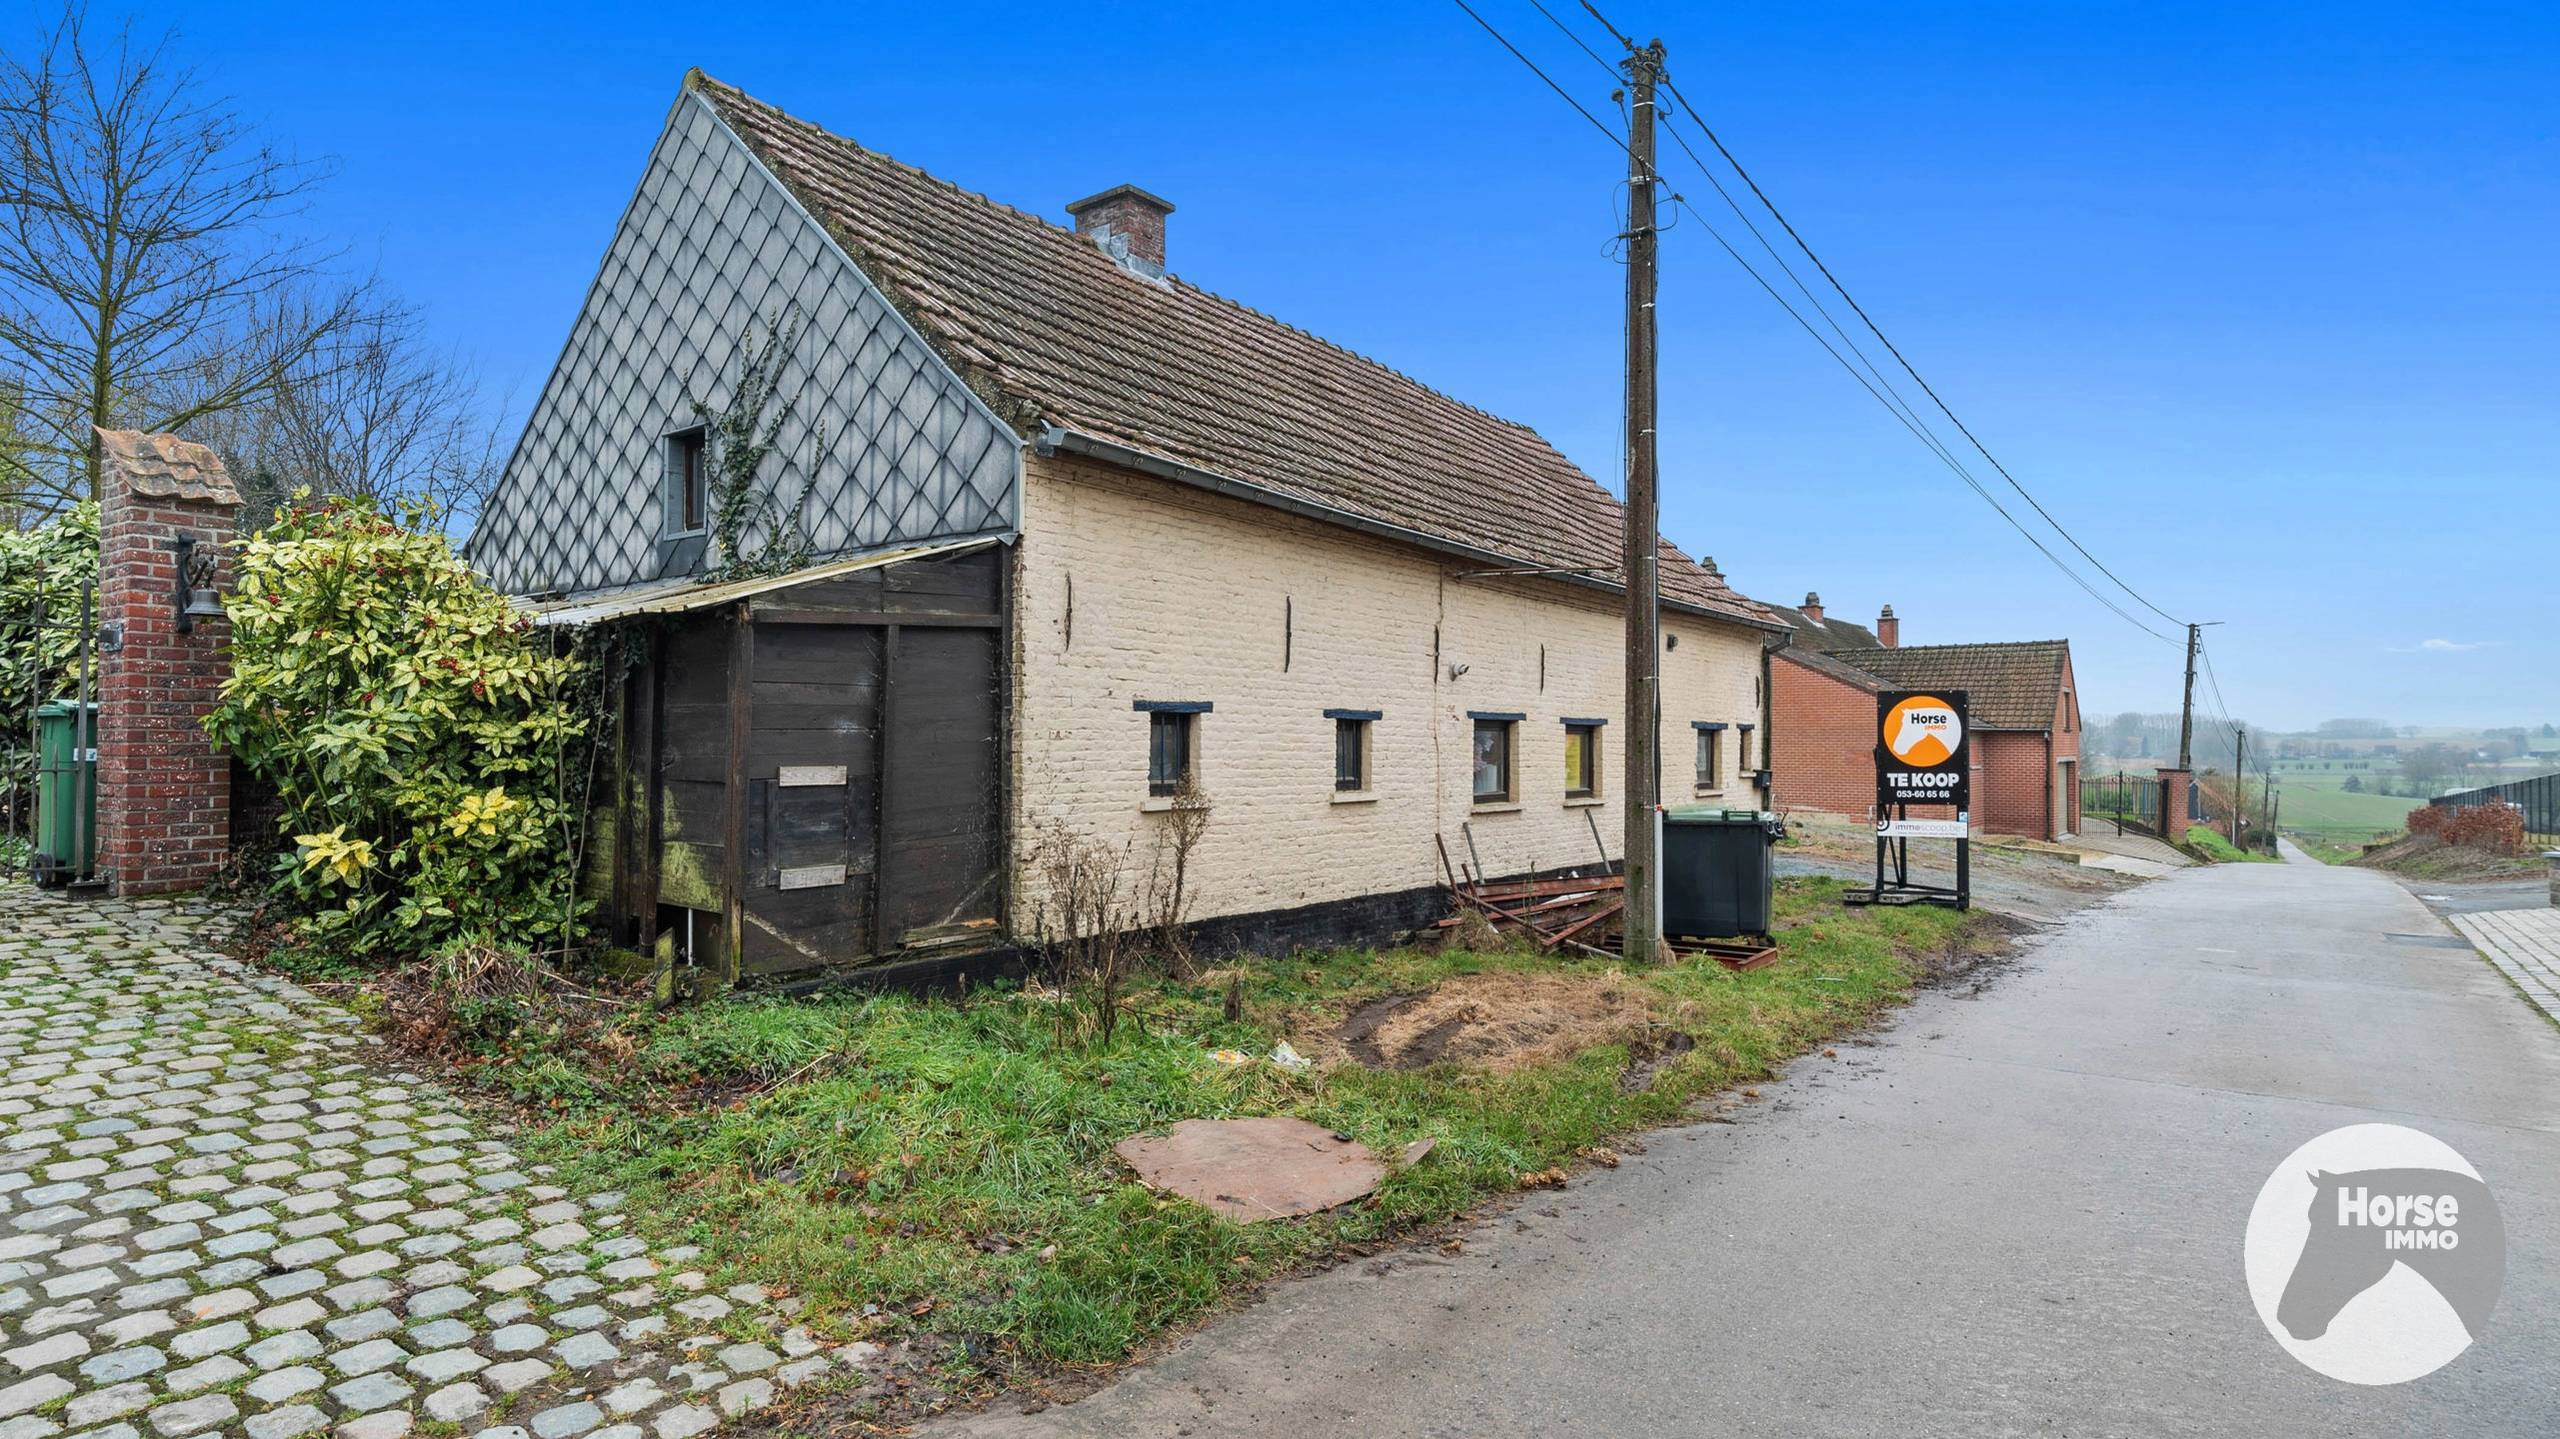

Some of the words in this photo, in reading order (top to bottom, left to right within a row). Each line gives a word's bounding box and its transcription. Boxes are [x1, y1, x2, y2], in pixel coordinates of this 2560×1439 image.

[1911, 713, 1947, 724] Horse
[1887, 773, 1909, 787] TE
[1911, 773, 1960, 787] KOOP
[1896, 790, 1925, 798] 053-60
[1926, 790, 1937, 798] 65
[1939, 790, 1950, 798] 66
